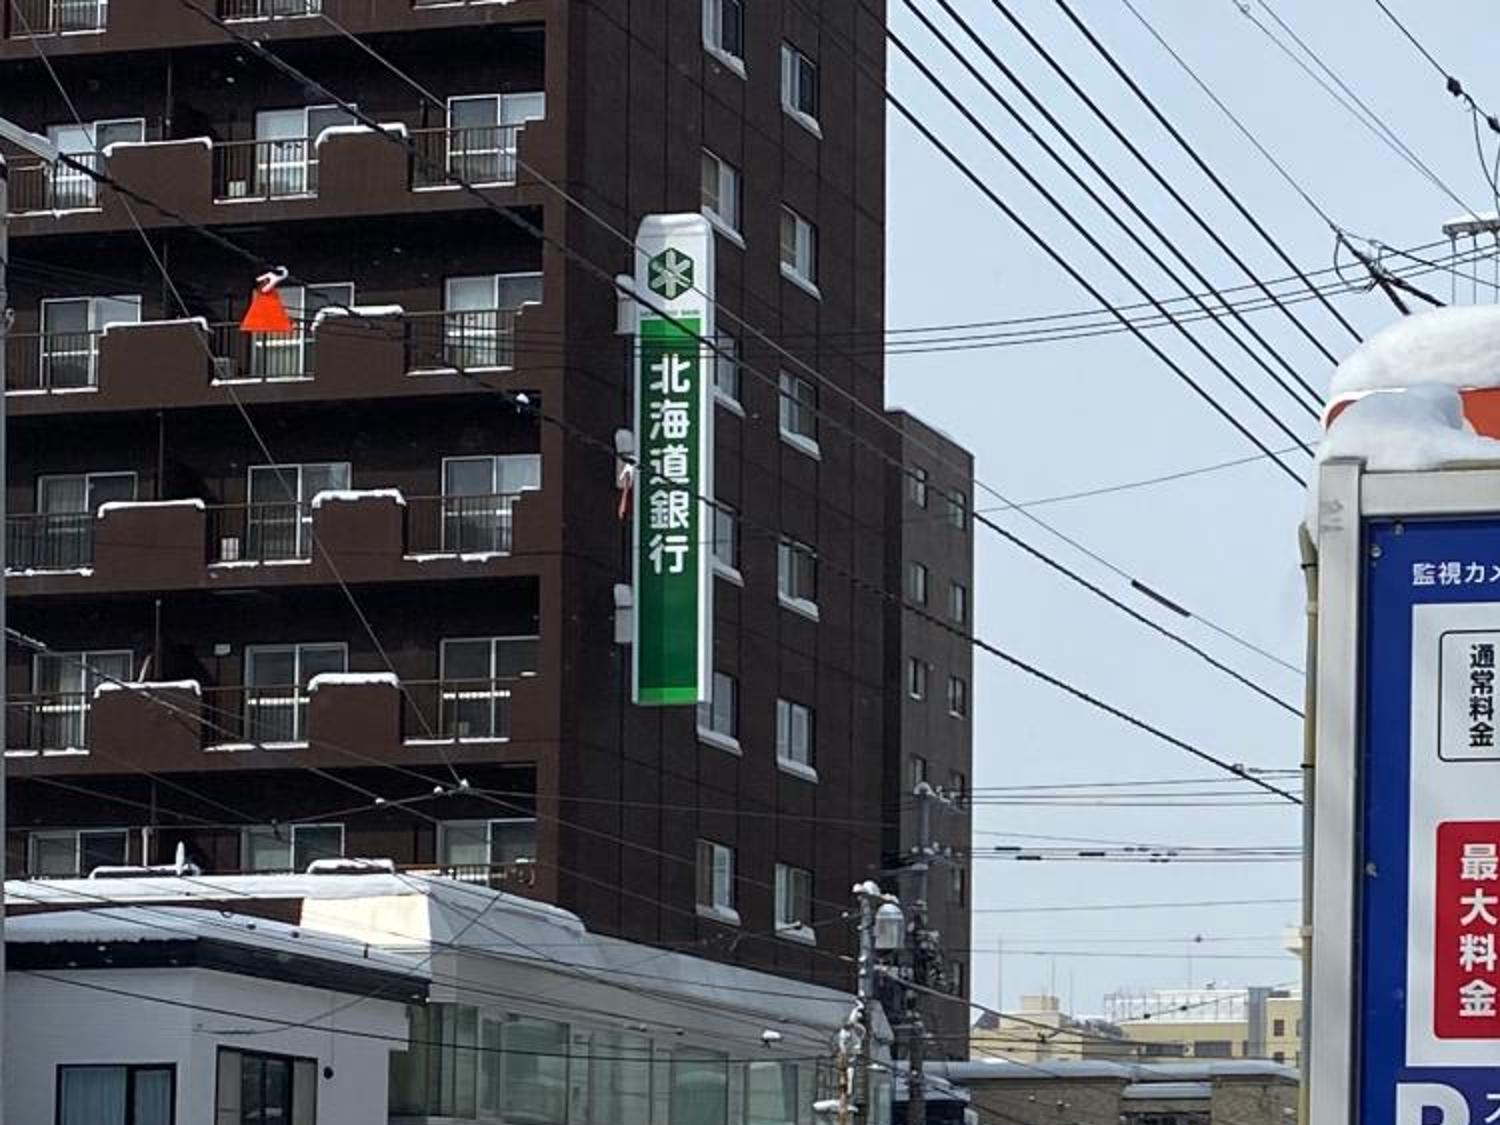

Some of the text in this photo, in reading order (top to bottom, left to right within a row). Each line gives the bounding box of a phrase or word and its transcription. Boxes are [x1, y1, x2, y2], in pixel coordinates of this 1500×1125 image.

[650, 354, 691, 574] 北海道銀行
[1468, 643, 1496, 748] 通常料金
[1458, 842, 1498, 1019] 最大料金
